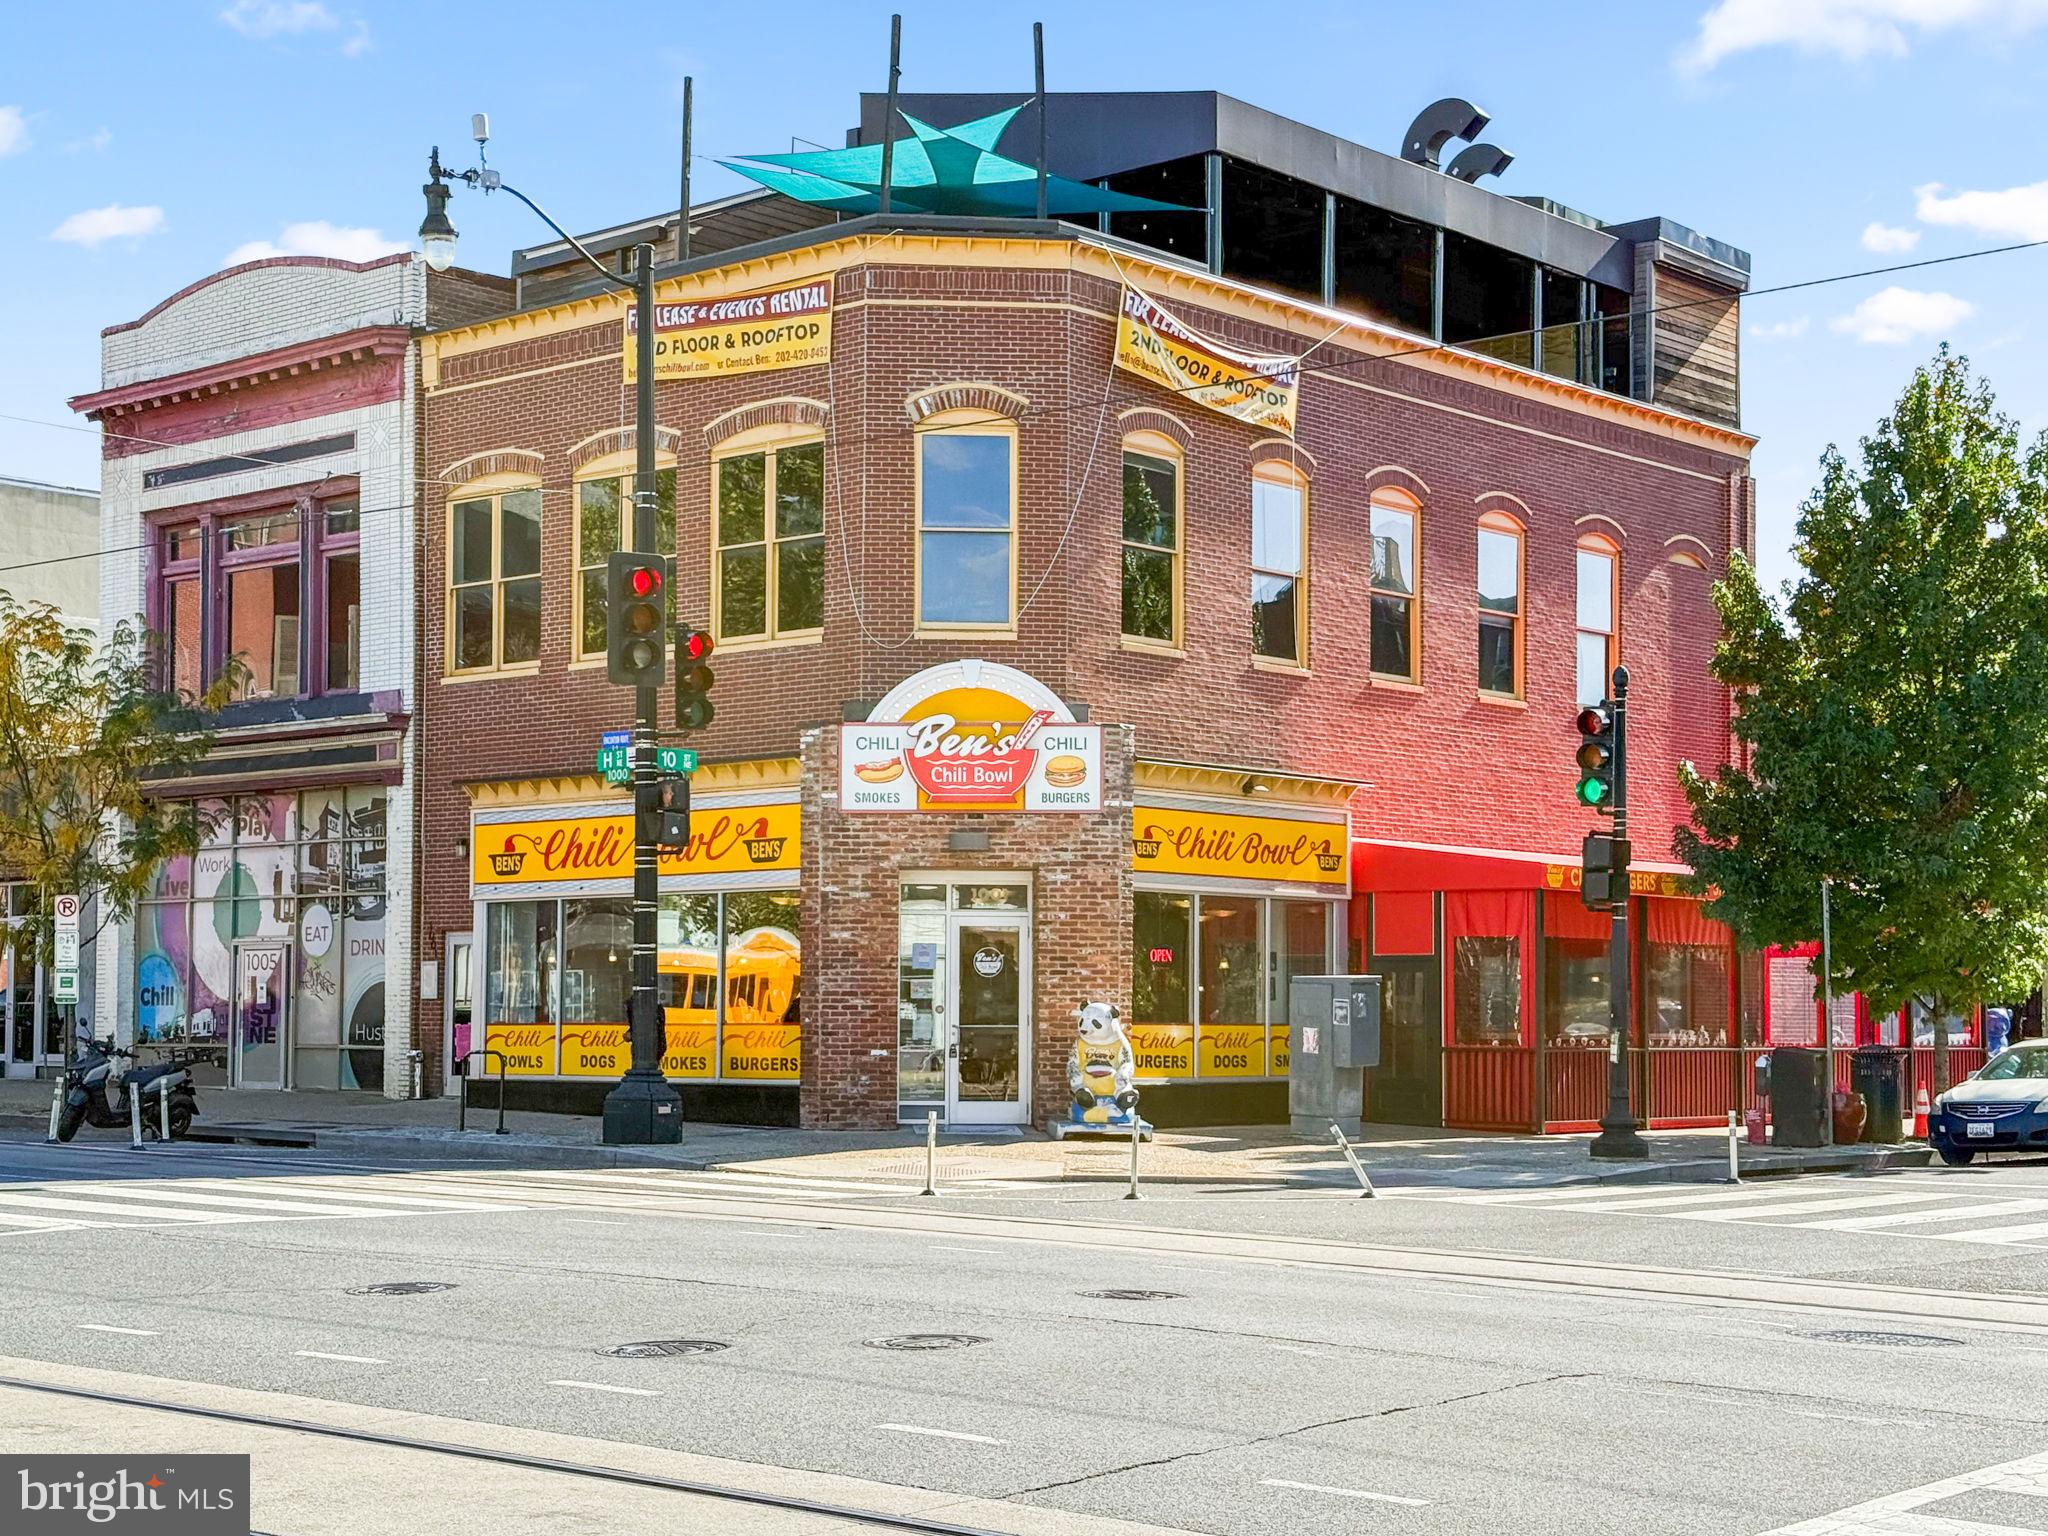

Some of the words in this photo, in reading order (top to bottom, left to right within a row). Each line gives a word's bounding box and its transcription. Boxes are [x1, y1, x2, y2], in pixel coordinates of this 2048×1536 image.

[656, 304, 695, 327] LEASE
[698, 309, 707, 319] &
[709, 295, 767, 321] EVENTS
[770, 285, 828, 315] RENTAL
[672, 334, 719, 355] FLOOR
[725, 333, 735, 348] &
[741, 322, 820, 346] ROOFTOP
[1212, 370, 1222, 385] &
[856, 736, 900, 750] CHILI
[907, 713, 1017, 758] Ben's
[1044, 736, 1088, 750] CHILI
[603, 752, 613, 769] H
[662, 751, 677, 768] 10
[607, 769, 628, 780] 1000
[931, 766, 967, 783] Chili
[974, 766, 1013, 783] Bowl
[854, 792, 901, 804] SMOKES
[1041, 792, 1090, 804] BURGERS
[237, 816, 274, 841] Play
[543, 825, 628, 872] Chili
[751, 839, 782, 860] BEN'S
[1136, 841, 1158, 857] BEN'S
[1174, 825, 1236, 861] Chili
[1242, 832, 1308, 865] Bowl
[199, 856, 232, 873] Work
[495, 854, 522, 873] BEN'S
[1320, 855, 1339, 869] BEN'S
[156, 874, 190, 897] Live
[305, 926, 329, 942] EAT
[351, 940, 385, 956] DRIN
[1150, 948, 1173, 962] OPEN
[246, 953, 278, 971] 1005
[140, 985, 175, 1007] Chill
[250, 1027, 276, 1044] NE
[355, 1024, 385, 1041] Hust
[504, 1030, 542, 1048] Chili
[580, 1030, 621, 1048] Chili
[743, 1030, 786, 1049] Chili
[1139, 1031, 1178, 1049] Chili
[1213, 1031, 1250, 1049] Chili
[580, 1055, 616, 1069] DOGS
[661, 1056, 707, 1071] MOKES
[730, 1056, 799, 1072] BURGERS
[1135, 1054, 1187, 1069] URGERS
[1213, 1055, 1248, 1068] DOGS
